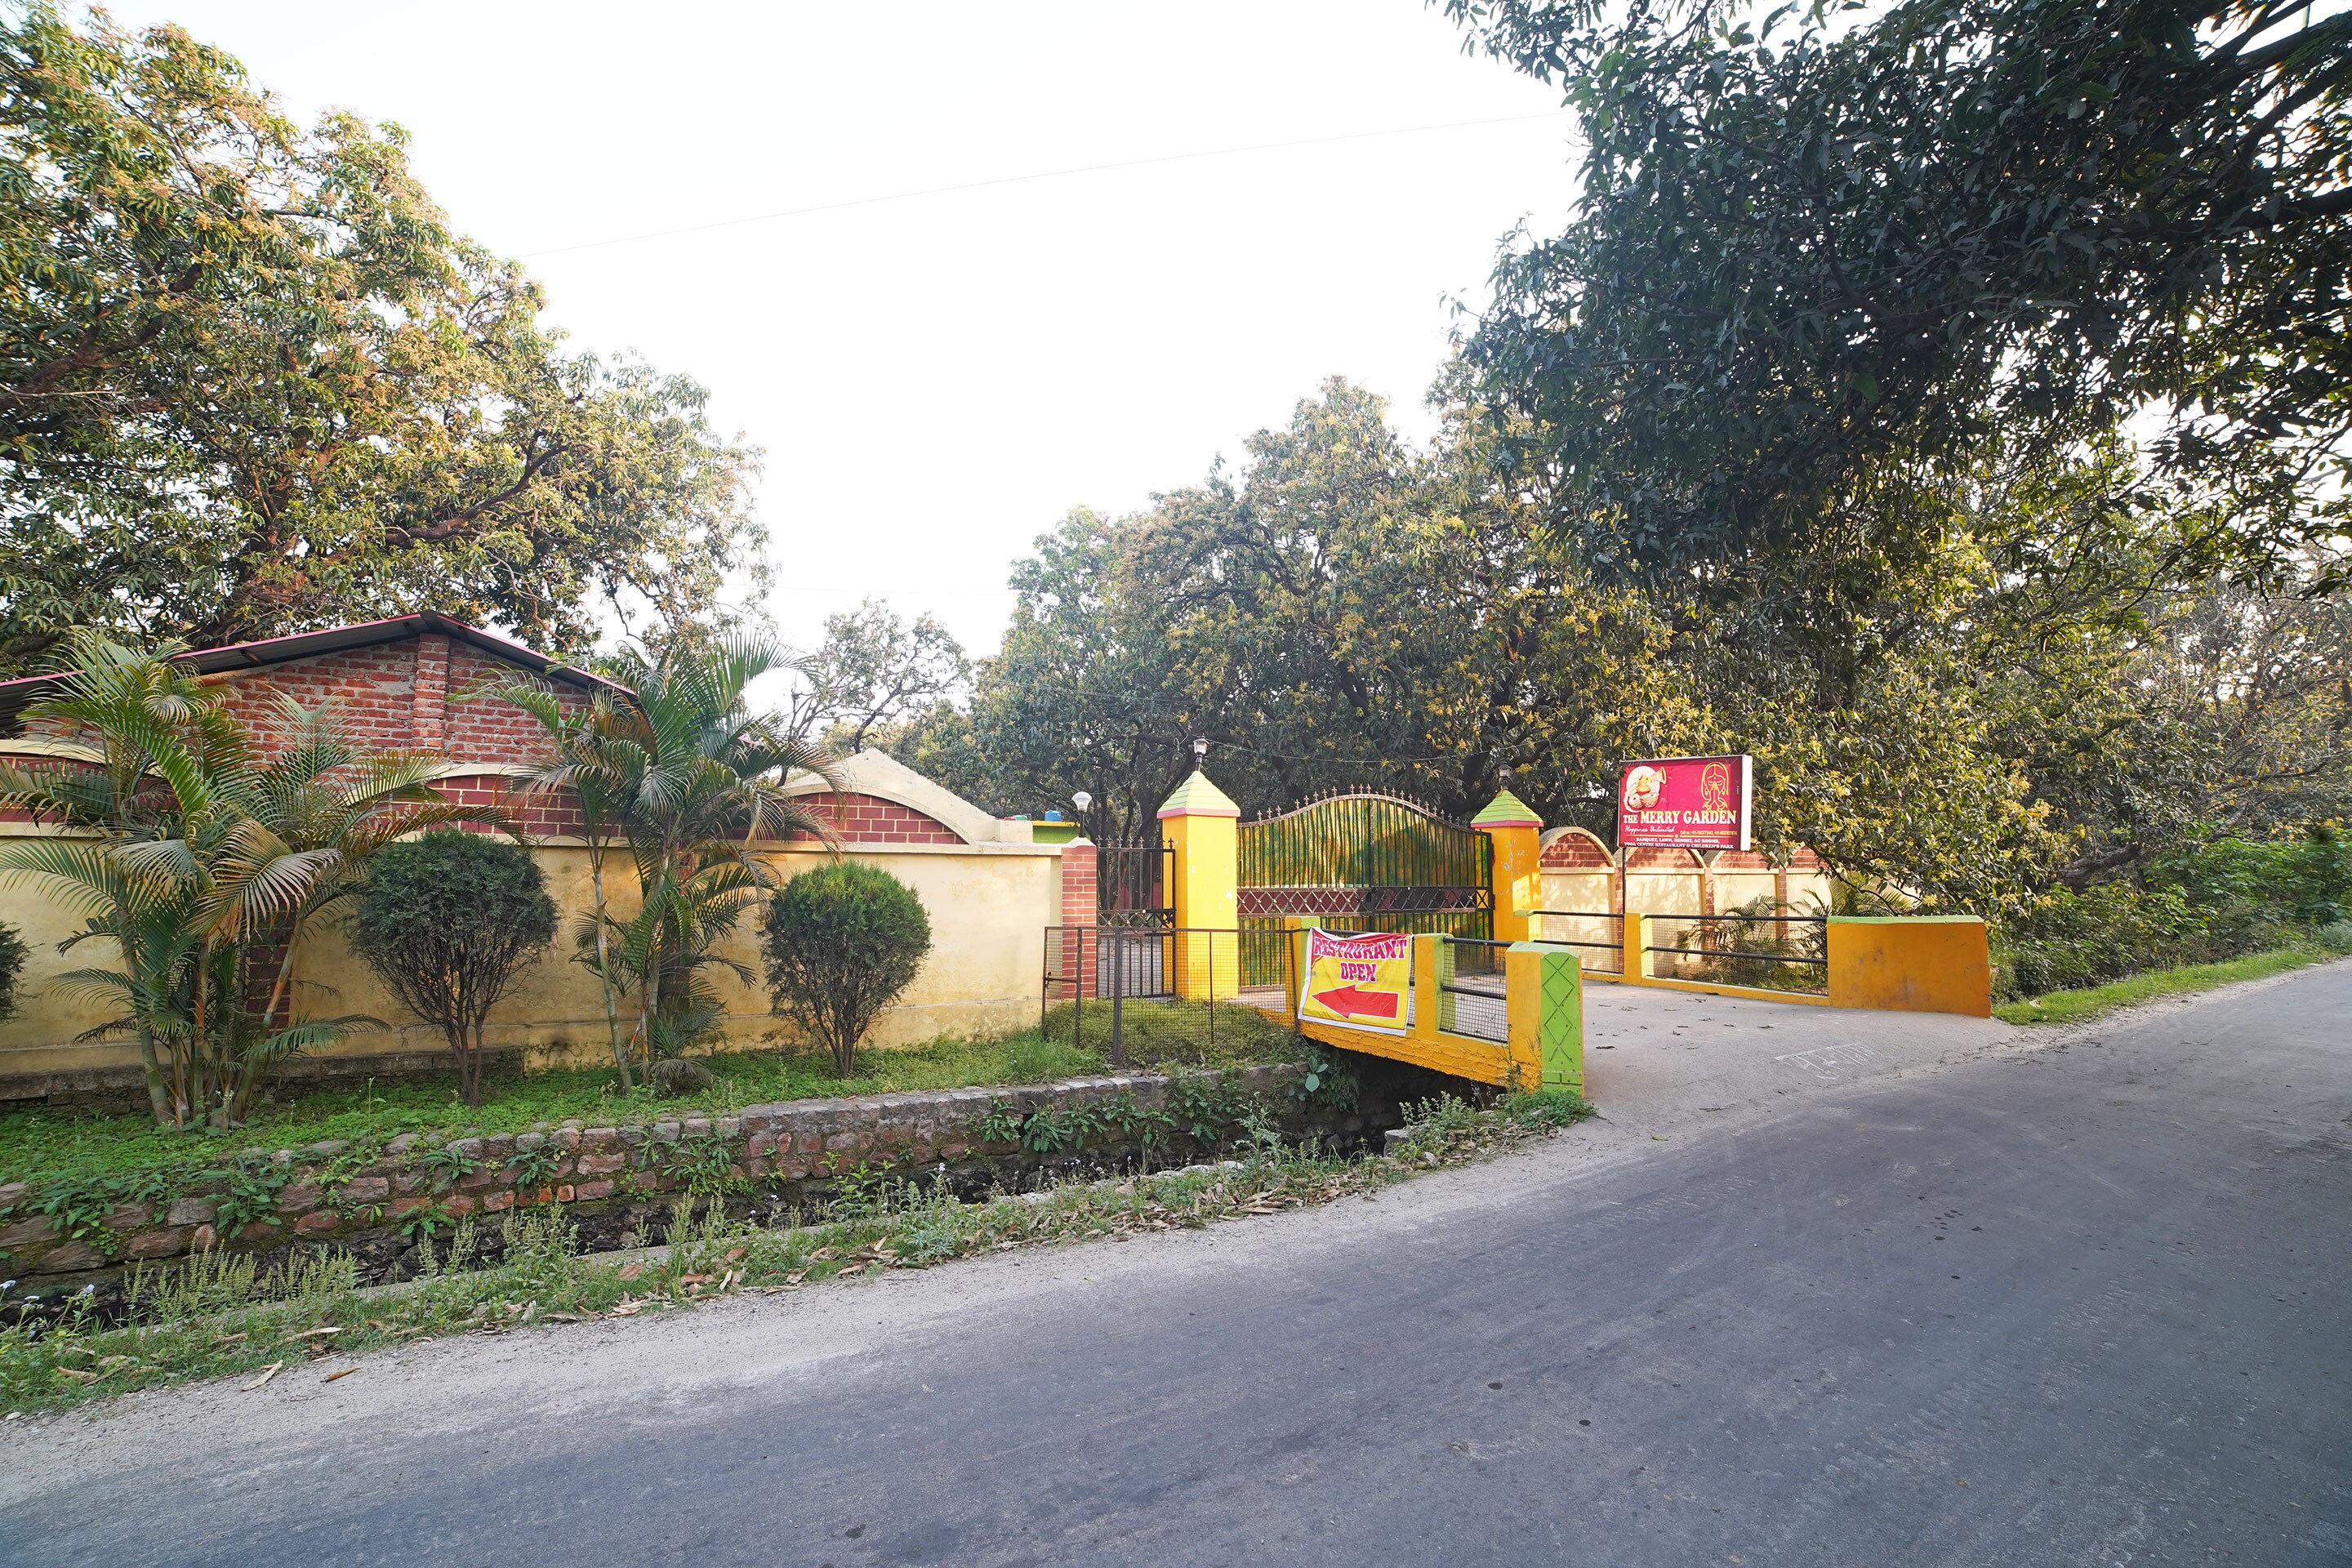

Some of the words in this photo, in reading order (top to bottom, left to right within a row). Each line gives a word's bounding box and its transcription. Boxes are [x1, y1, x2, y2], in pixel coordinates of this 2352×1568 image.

[1623, 814, 1638, 824] THE
[1640, 810, 1681, 824] MERRY
[1683, 810, 1737, 824] GARDEN
[1650, 825, 1675, 833] Unlimited
[1313, 937, 1407, 960] RESTAURANT
[1340, 962, 1377, 982] OPEN
